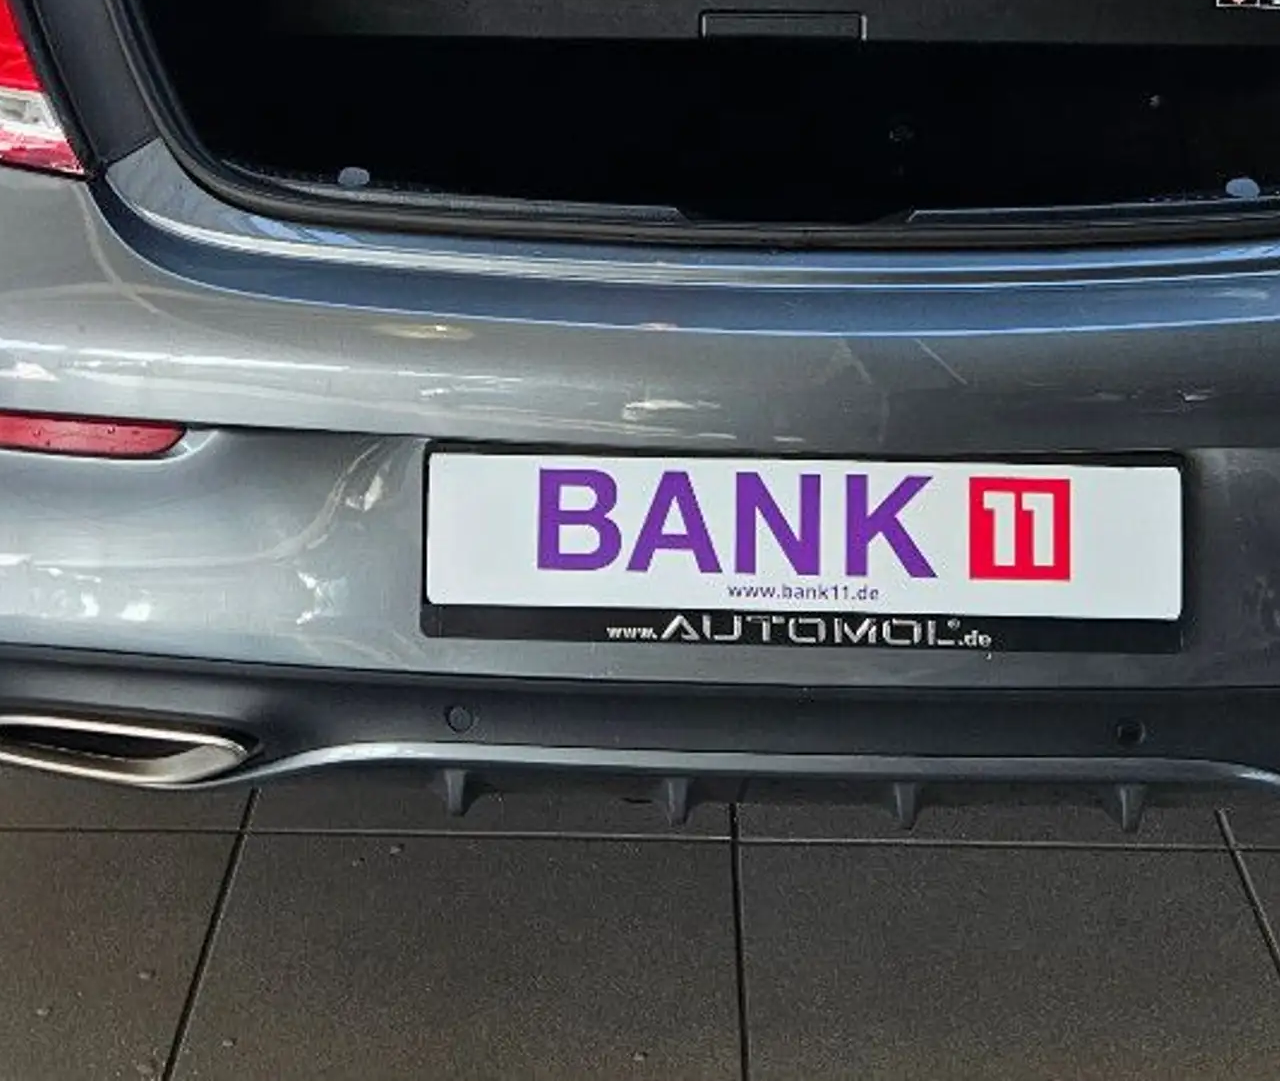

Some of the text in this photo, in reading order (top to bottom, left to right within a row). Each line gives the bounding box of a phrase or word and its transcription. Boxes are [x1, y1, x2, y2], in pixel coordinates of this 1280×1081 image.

[537, 468, 1058, 580] BANK 11
[726, 581, 880, 601] www.bank11.de
